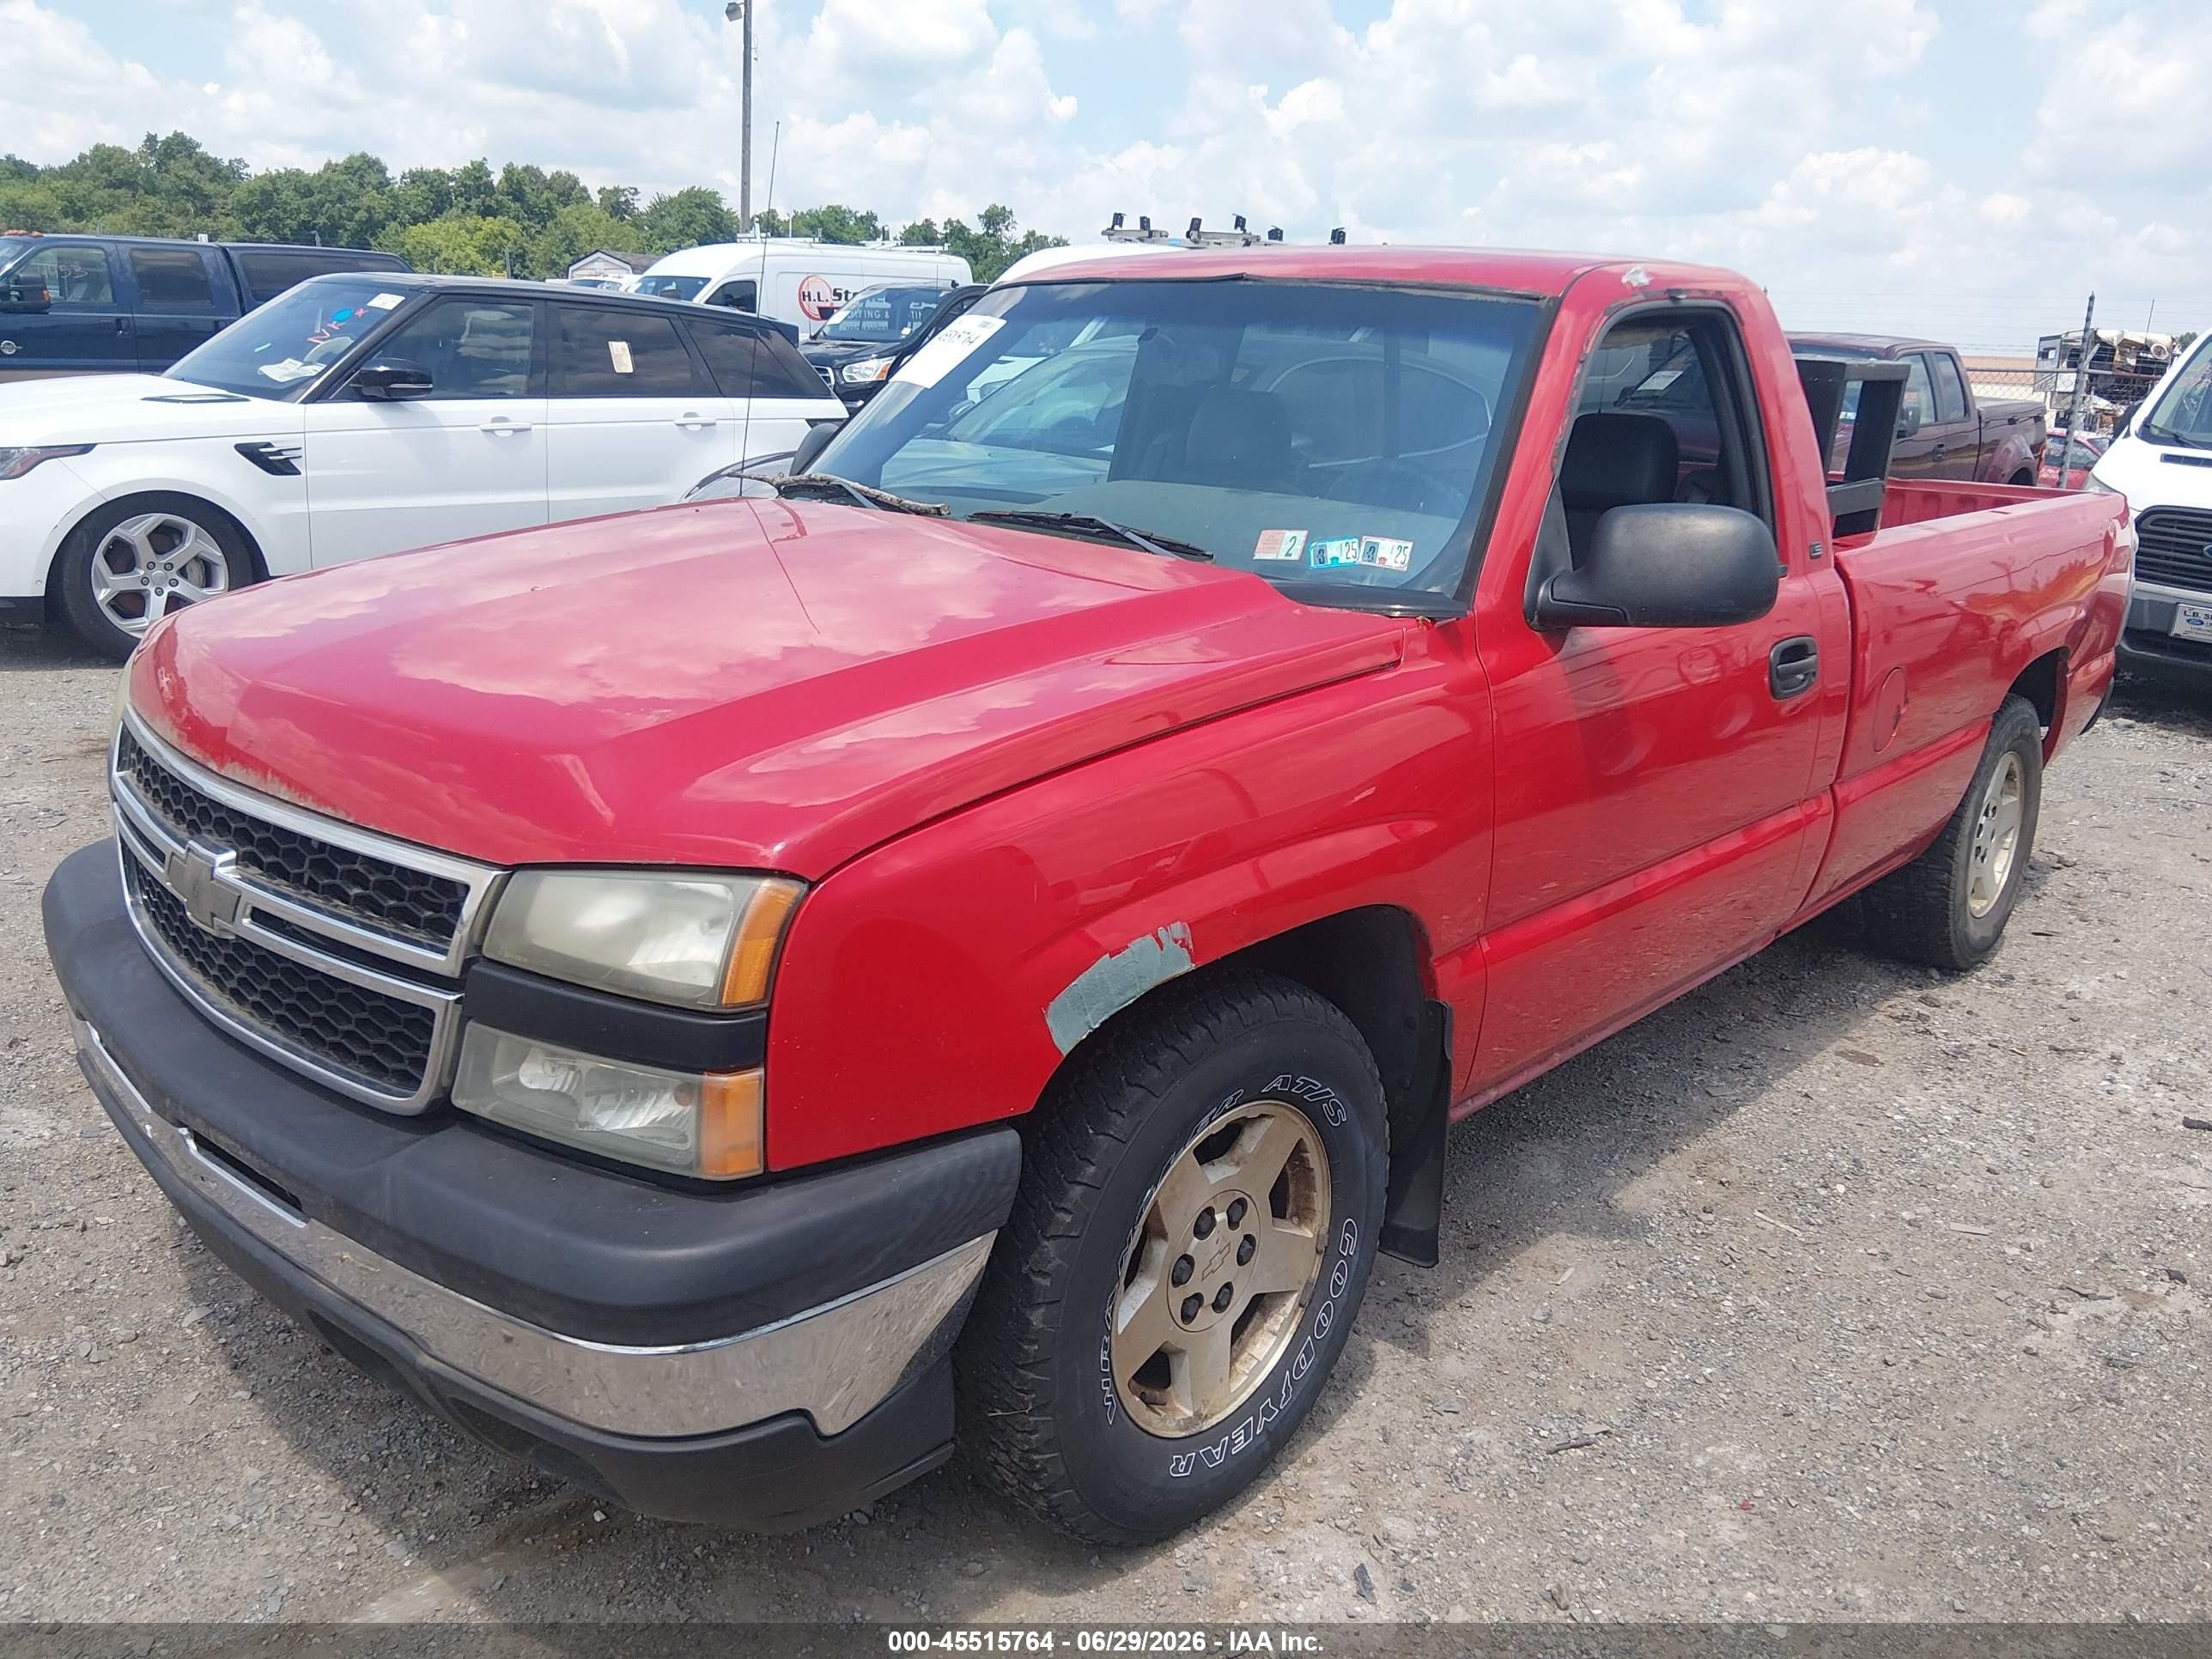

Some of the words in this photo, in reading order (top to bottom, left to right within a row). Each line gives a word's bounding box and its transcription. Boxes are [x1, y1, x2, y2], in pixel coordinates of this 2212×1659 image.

[802, 289, 830, 302] H.L.
[1284, 535, 1297, 557] 2
[1345, 541, 1358, 560] 25
[1394, 544, 1409, 565] 25
[1170, 1218, 1358, 1477] GOODYEAR
